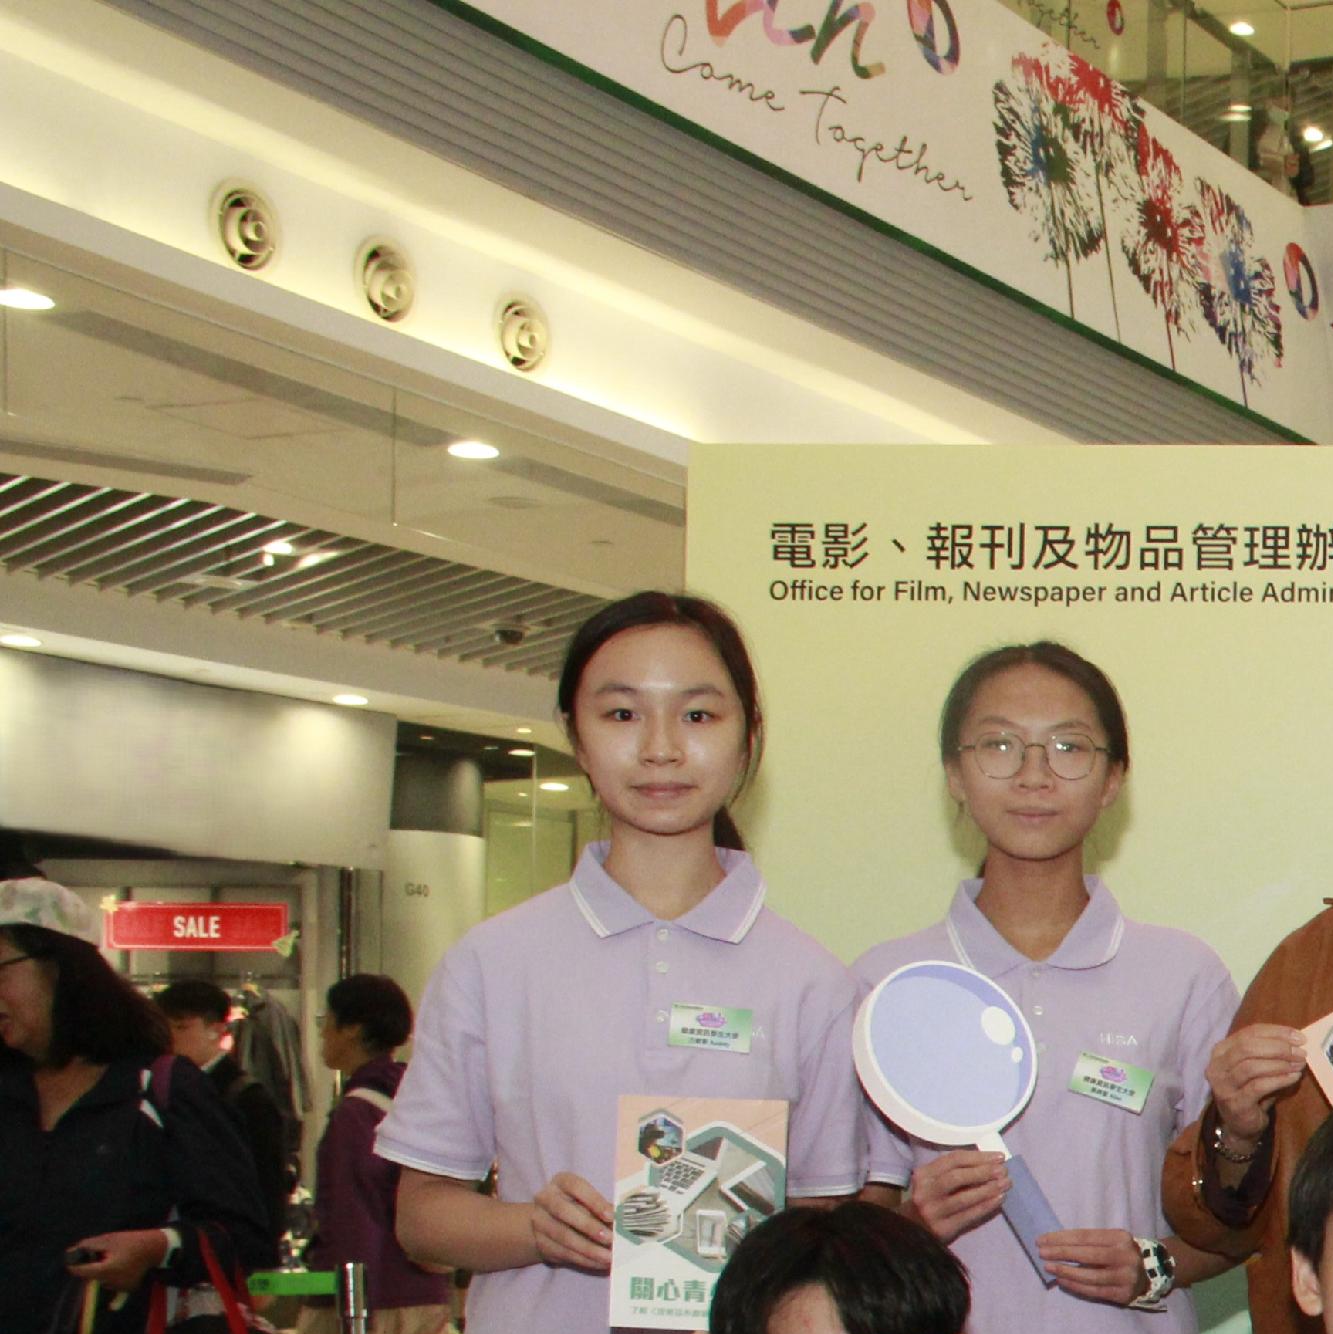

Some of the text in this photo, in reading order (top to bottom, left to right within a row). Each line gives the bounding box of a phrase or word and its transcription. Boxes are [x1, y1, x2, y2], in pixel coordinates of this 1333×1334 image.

[659, 14, 785, 112] Come
[799, 86, 972, 201] Together
[769, 579, 844, 602] Office
[850, 579, 886, 602] for
[893, 579, 953, 605] Film,
[962, 580, 1107, 608] Newspaper
[1115, 580, 1162, 603] and
[1170, 580, 1254, 604] Article
[172, 915, 222, 939] SALE
